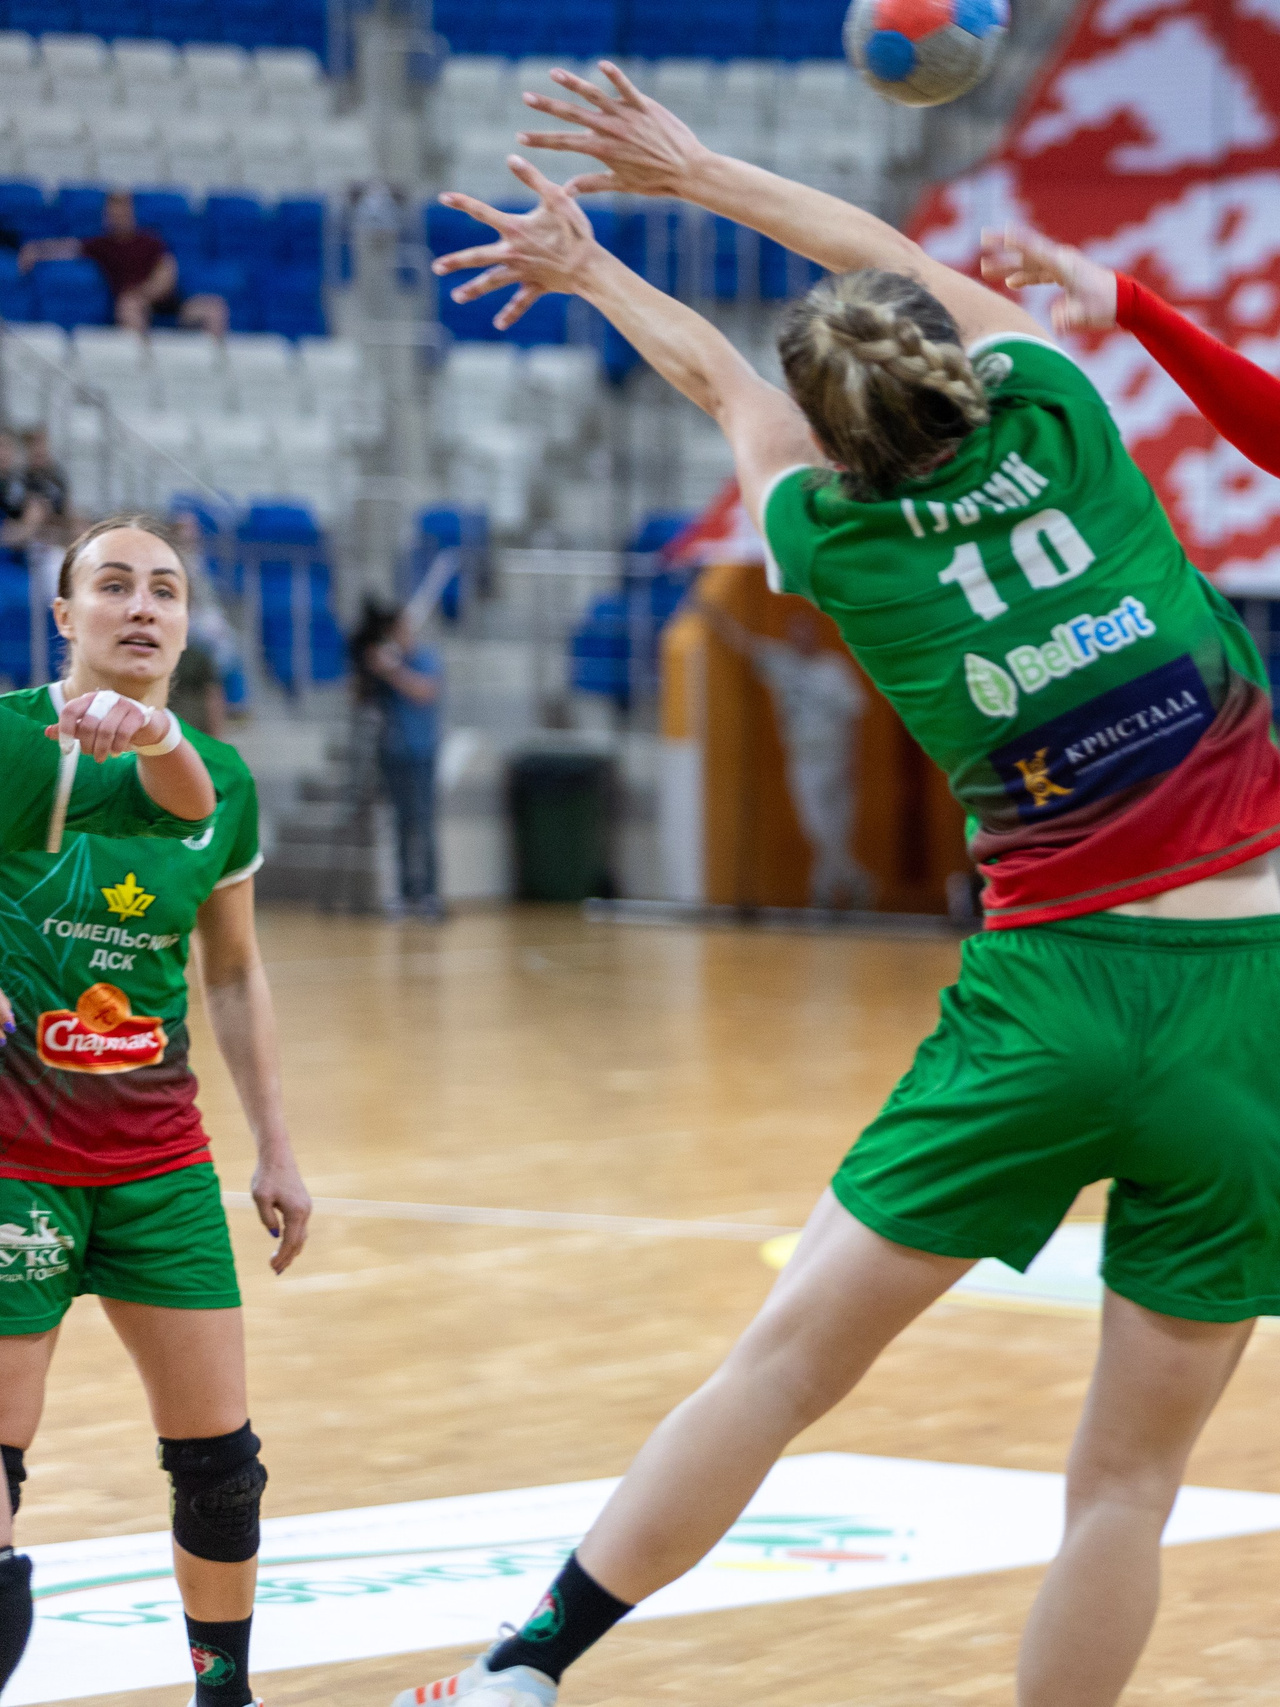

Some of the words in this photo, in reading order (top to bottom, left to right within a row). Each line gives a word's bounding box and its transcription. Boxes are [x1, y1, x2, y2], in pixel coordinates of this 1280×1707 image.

[937, 508, 1096, 621] 10
[1006, 596, 1155, 693] BelFert
[88, 948, 137, 971] ДСК
